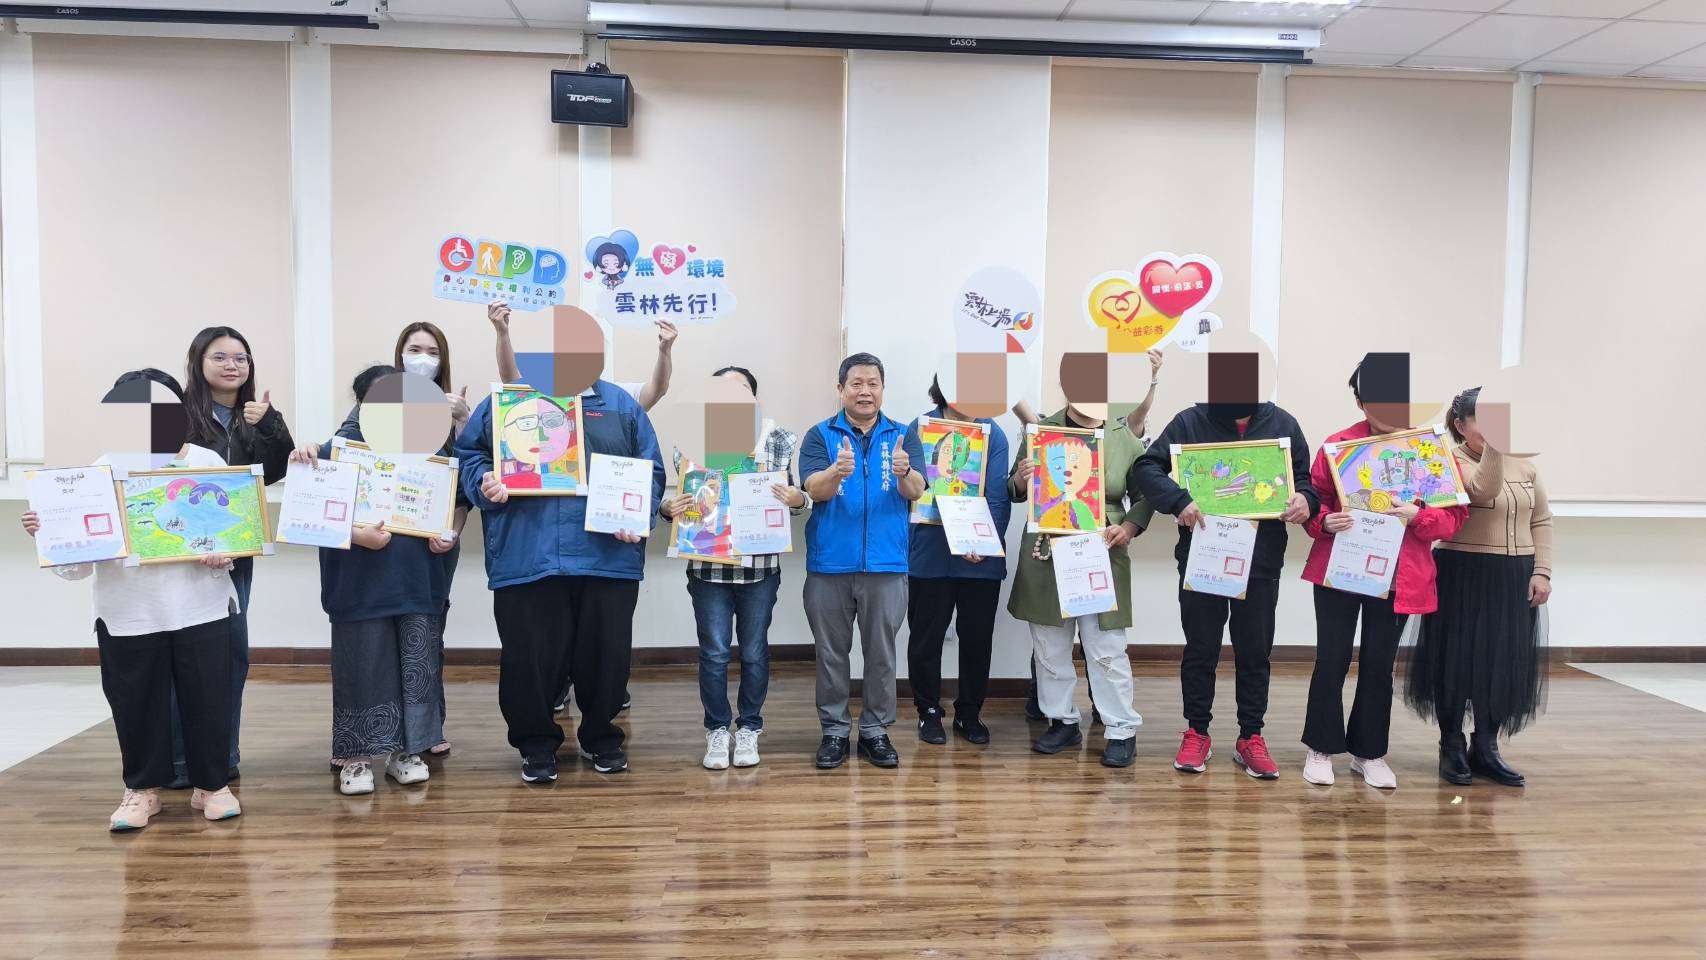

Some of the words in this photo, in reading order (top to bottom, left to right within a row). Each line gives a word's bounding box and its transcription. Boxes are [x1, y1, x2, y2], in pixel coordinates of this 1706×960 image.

[950, 38, 977, 47] CASOS
[615, 291, 718, 315] 雲林先行!
